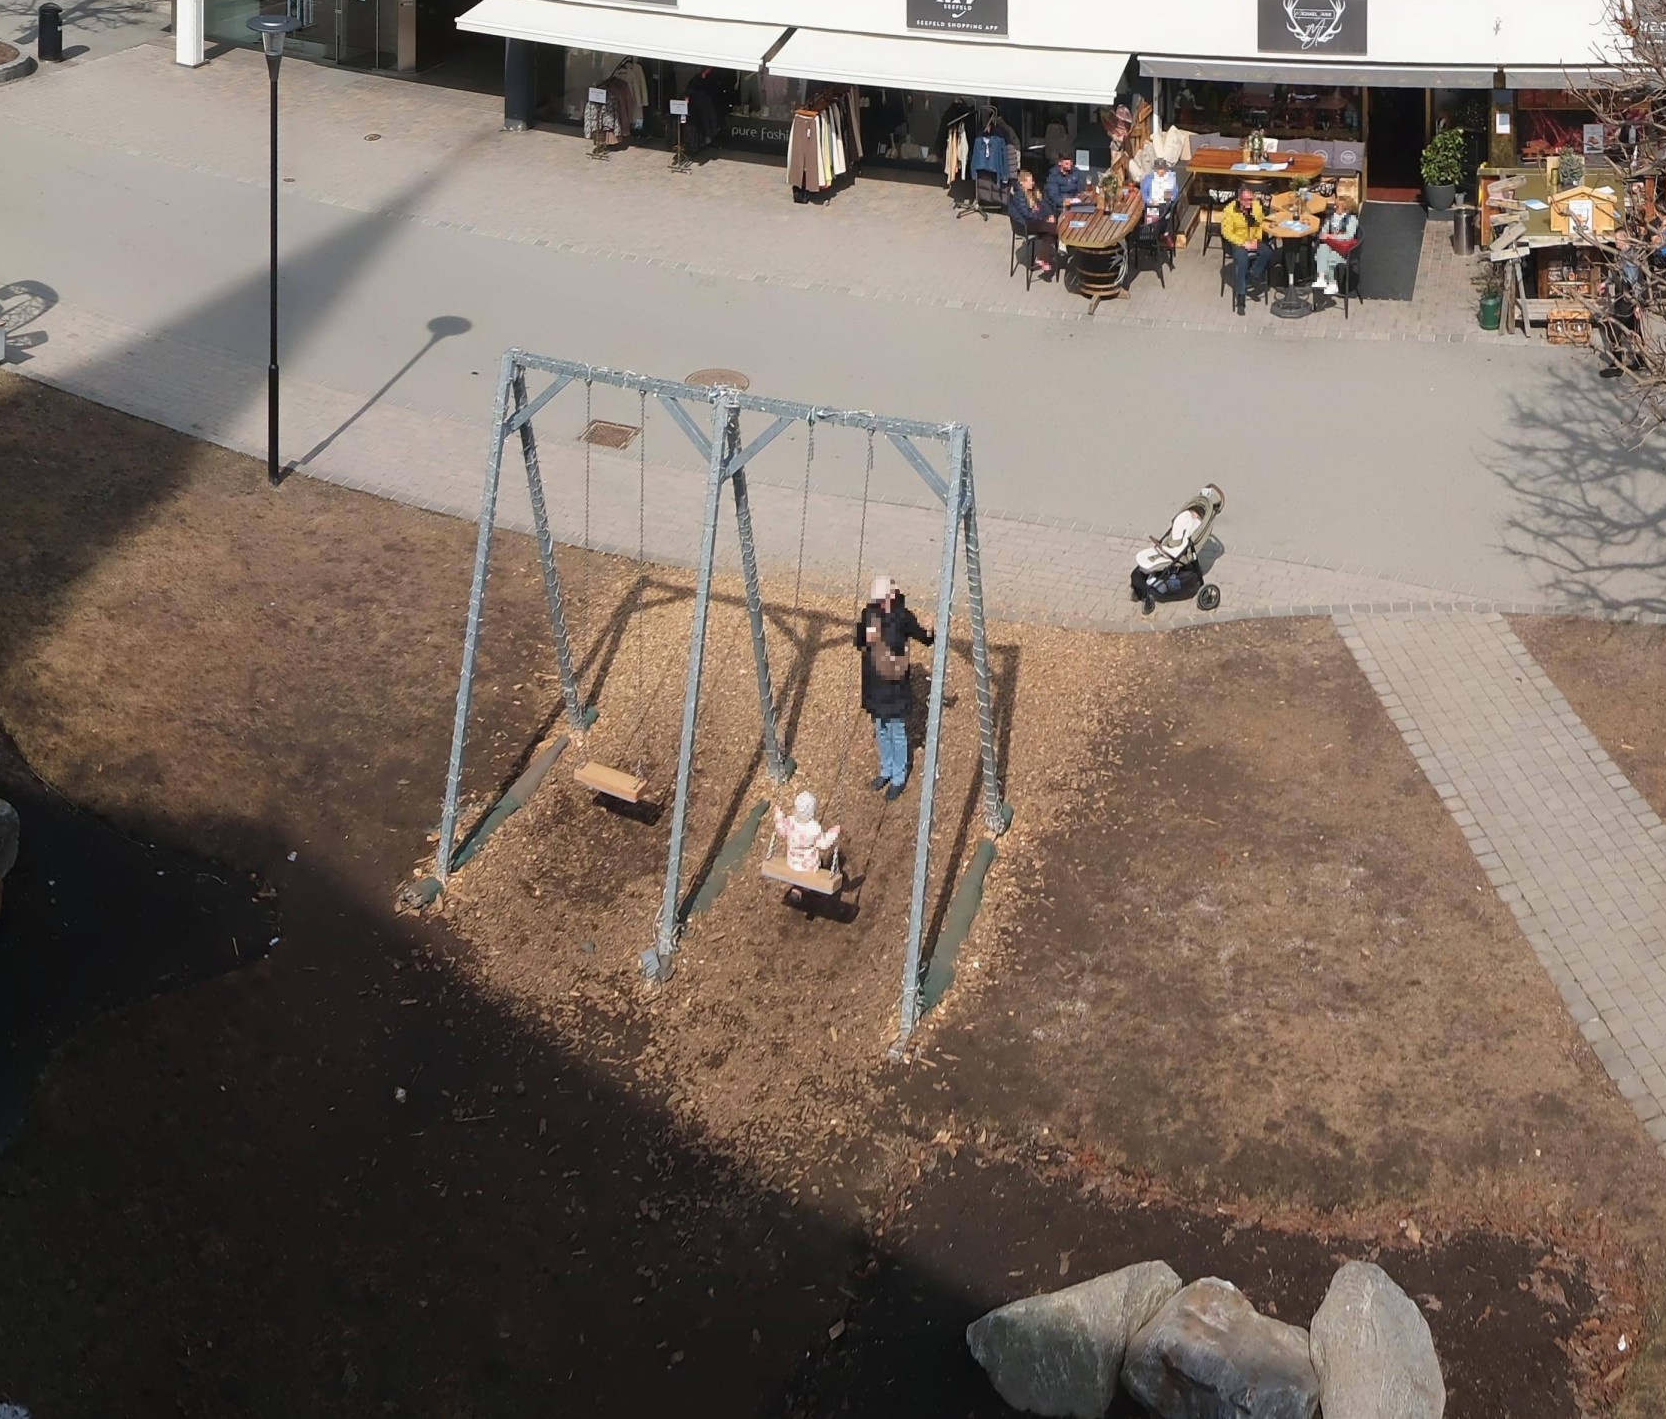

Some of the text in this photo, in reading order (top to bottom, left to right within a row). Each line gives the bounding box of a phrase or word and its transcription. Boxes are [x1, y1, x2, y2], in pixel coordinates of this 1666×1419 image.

[943, 3, 973, 12] SEEFELD
[916, 19, 999, 32] SEEFELD SHOPPING APP
[731, 126, 757, 138] pure
